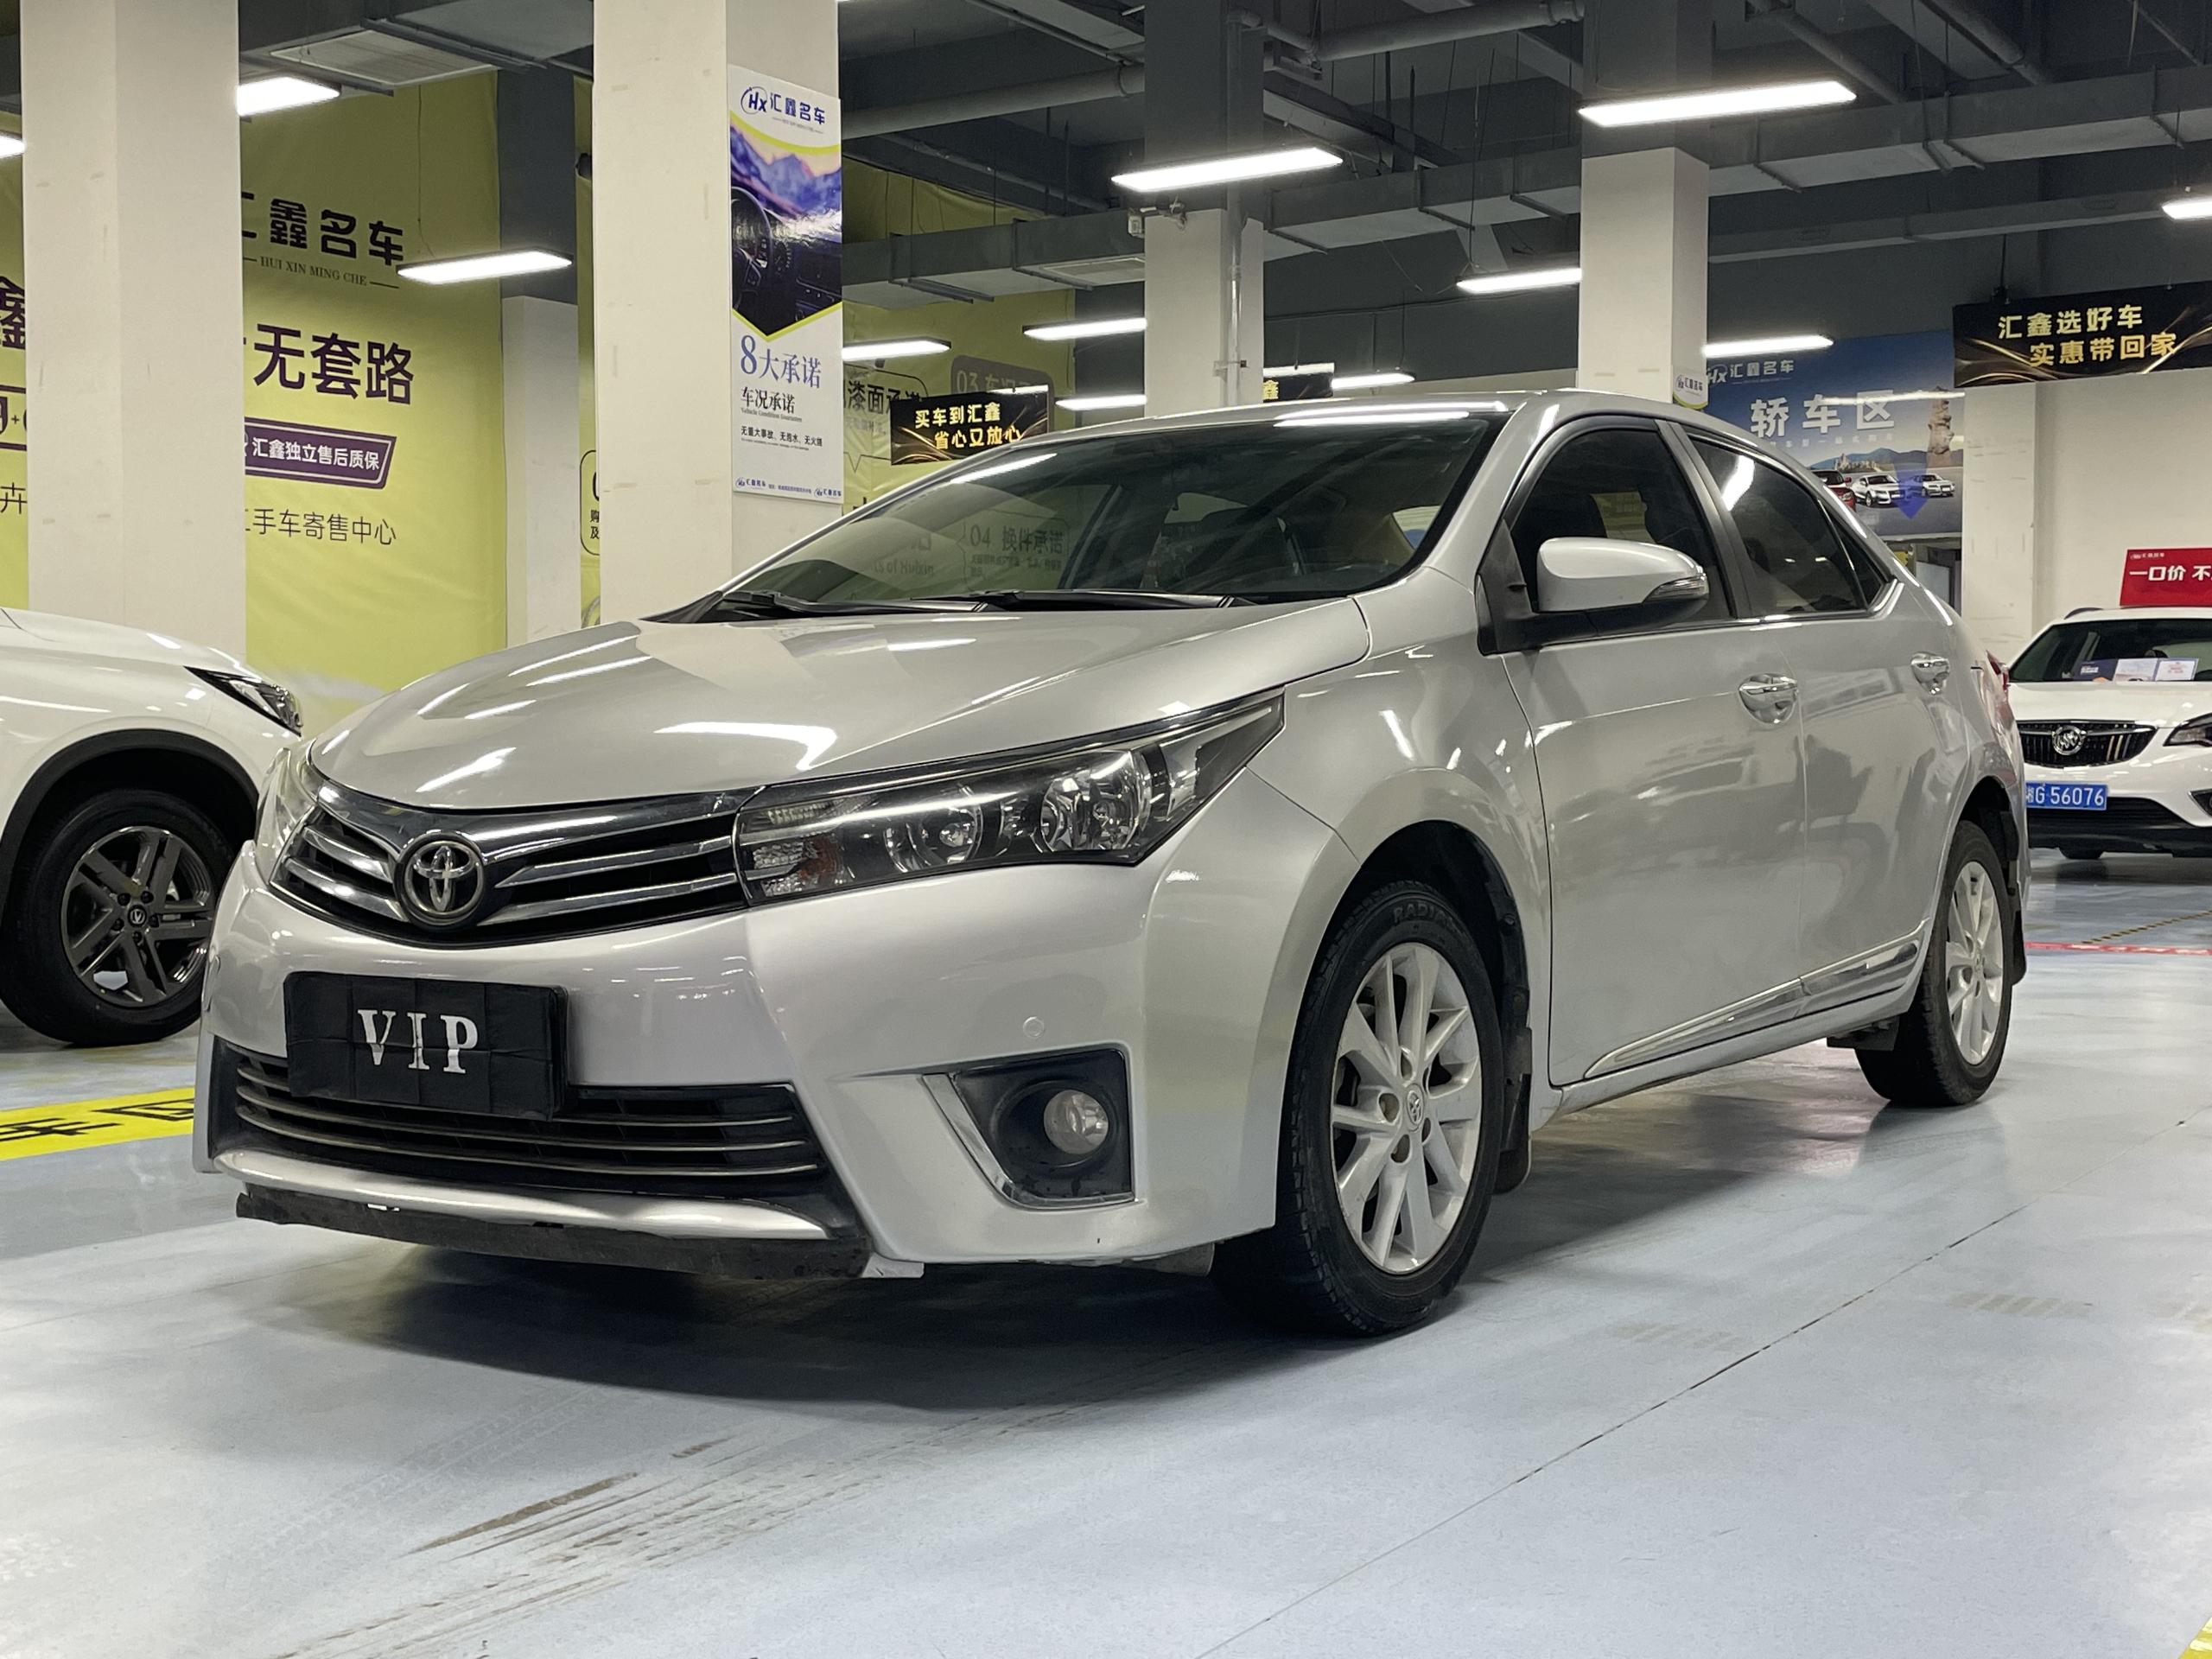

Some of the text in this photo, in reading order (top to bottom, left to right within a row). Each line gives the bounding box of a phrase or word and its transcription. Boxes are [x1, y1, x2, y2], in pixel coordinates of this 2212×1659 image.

[260, 256, 367, 286] HUI XIN MING CHE
[1998, 304, 2143, 340] 汇鑫选好车
[741, 334, 822, 389] 8大承诺
[2030, 332, 2177, 367] 实惠带回家
[741, 386, 795, 414] 车况承诺
[915, 402, 1001, 429] 买车到汇鑫
[1750, 390, 1894, 438] 轿车区
[252, 437, 380, 470] 汇鑫独立售后质保
[935, 424, 1021, 450] 省心又放心
[2129, 565, 2186, 581] 一口价
[358, 1009, 478, 1073] VIP
